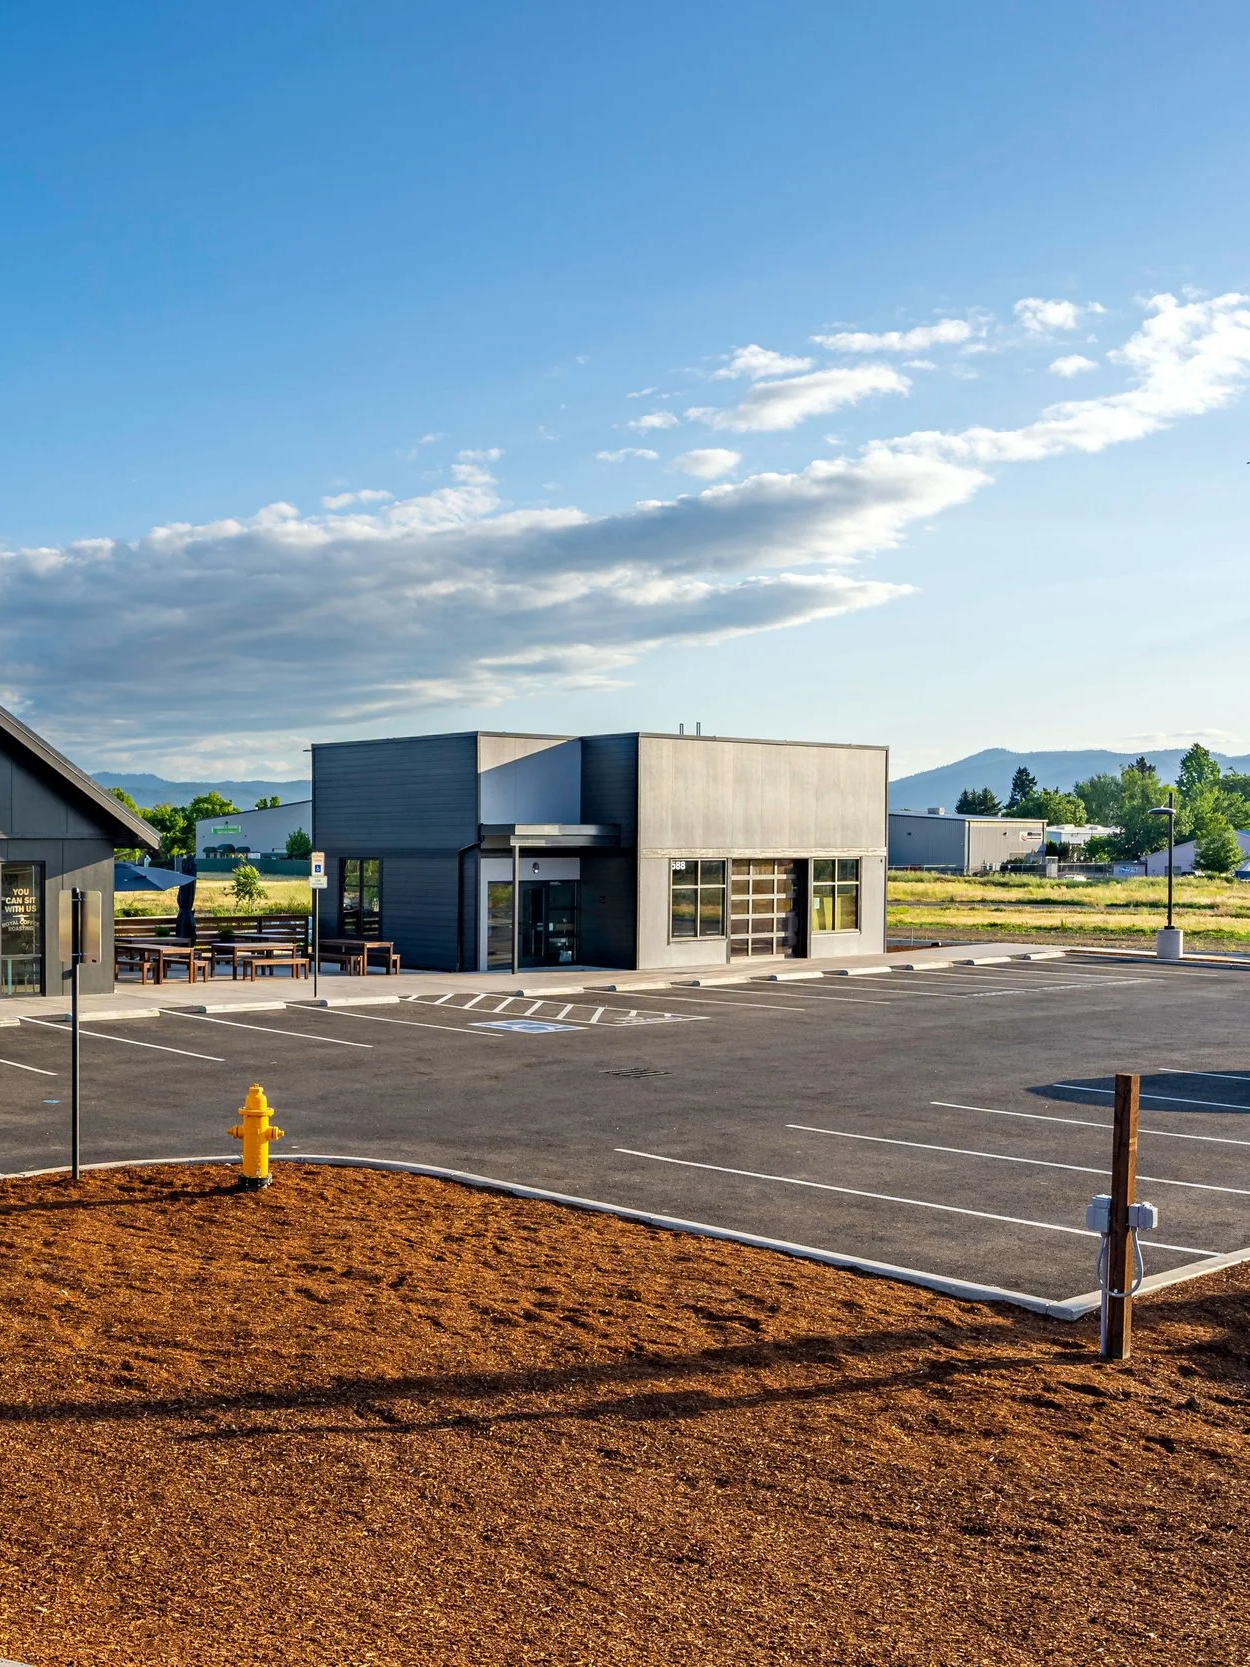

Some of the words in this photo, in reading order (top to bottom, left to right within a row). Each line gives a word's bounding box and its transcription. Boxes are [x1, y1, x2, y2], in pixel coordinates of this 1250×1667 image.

[671, 861, 686, 870] 588
[12, 888, 30, 896] YOU
[5, 897, 23, 905] CAN
[23, 896, 37, 904] SIT
[4, 905, 25, 913] WITH
[25, 904, 37, 912] US
[1, 920, 20, 928] ROYAL
